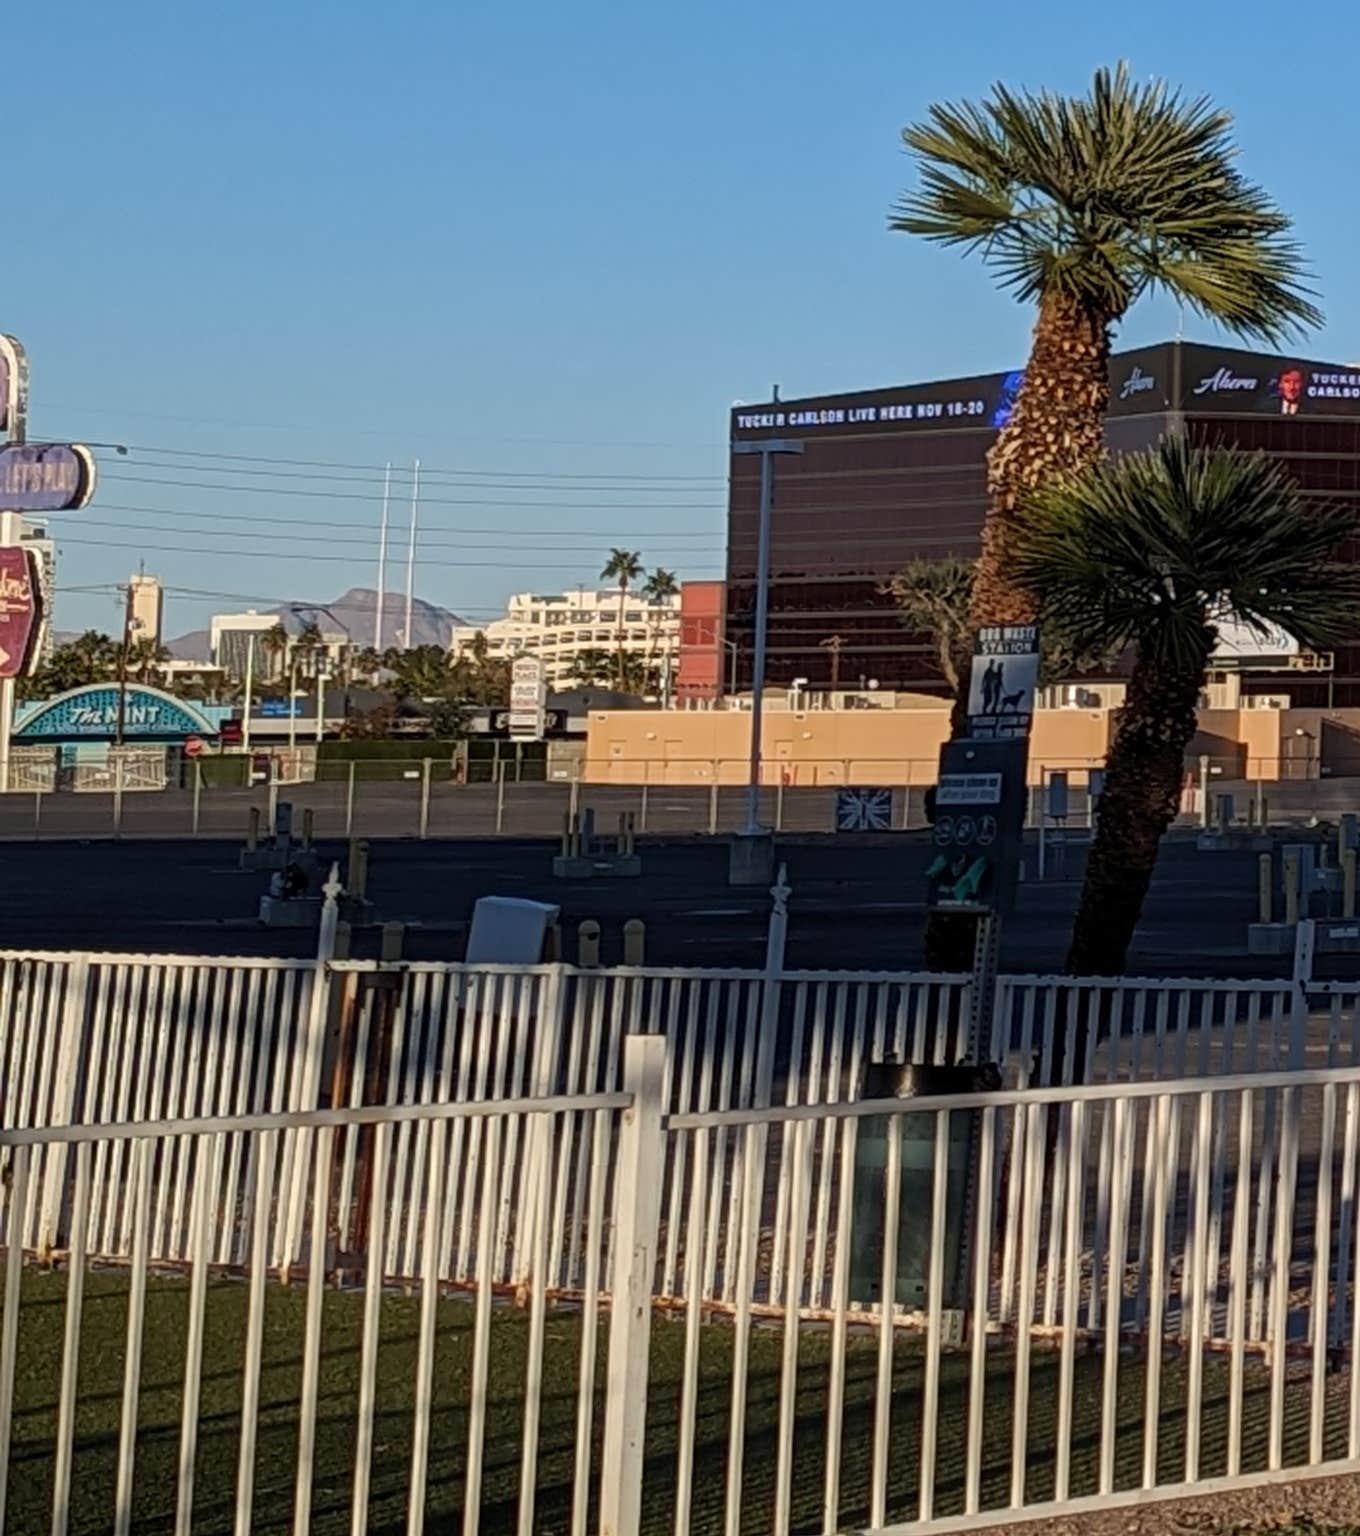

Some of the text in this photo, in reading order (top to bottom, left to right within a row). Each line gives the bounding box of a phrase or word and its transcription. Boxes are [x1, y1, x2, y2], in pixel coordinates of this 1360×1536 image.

[737, 400, 984, 428] TUCKER CARLSON LIVE HERE NOV 18-20
[104, 705, 160, 724] MINT
